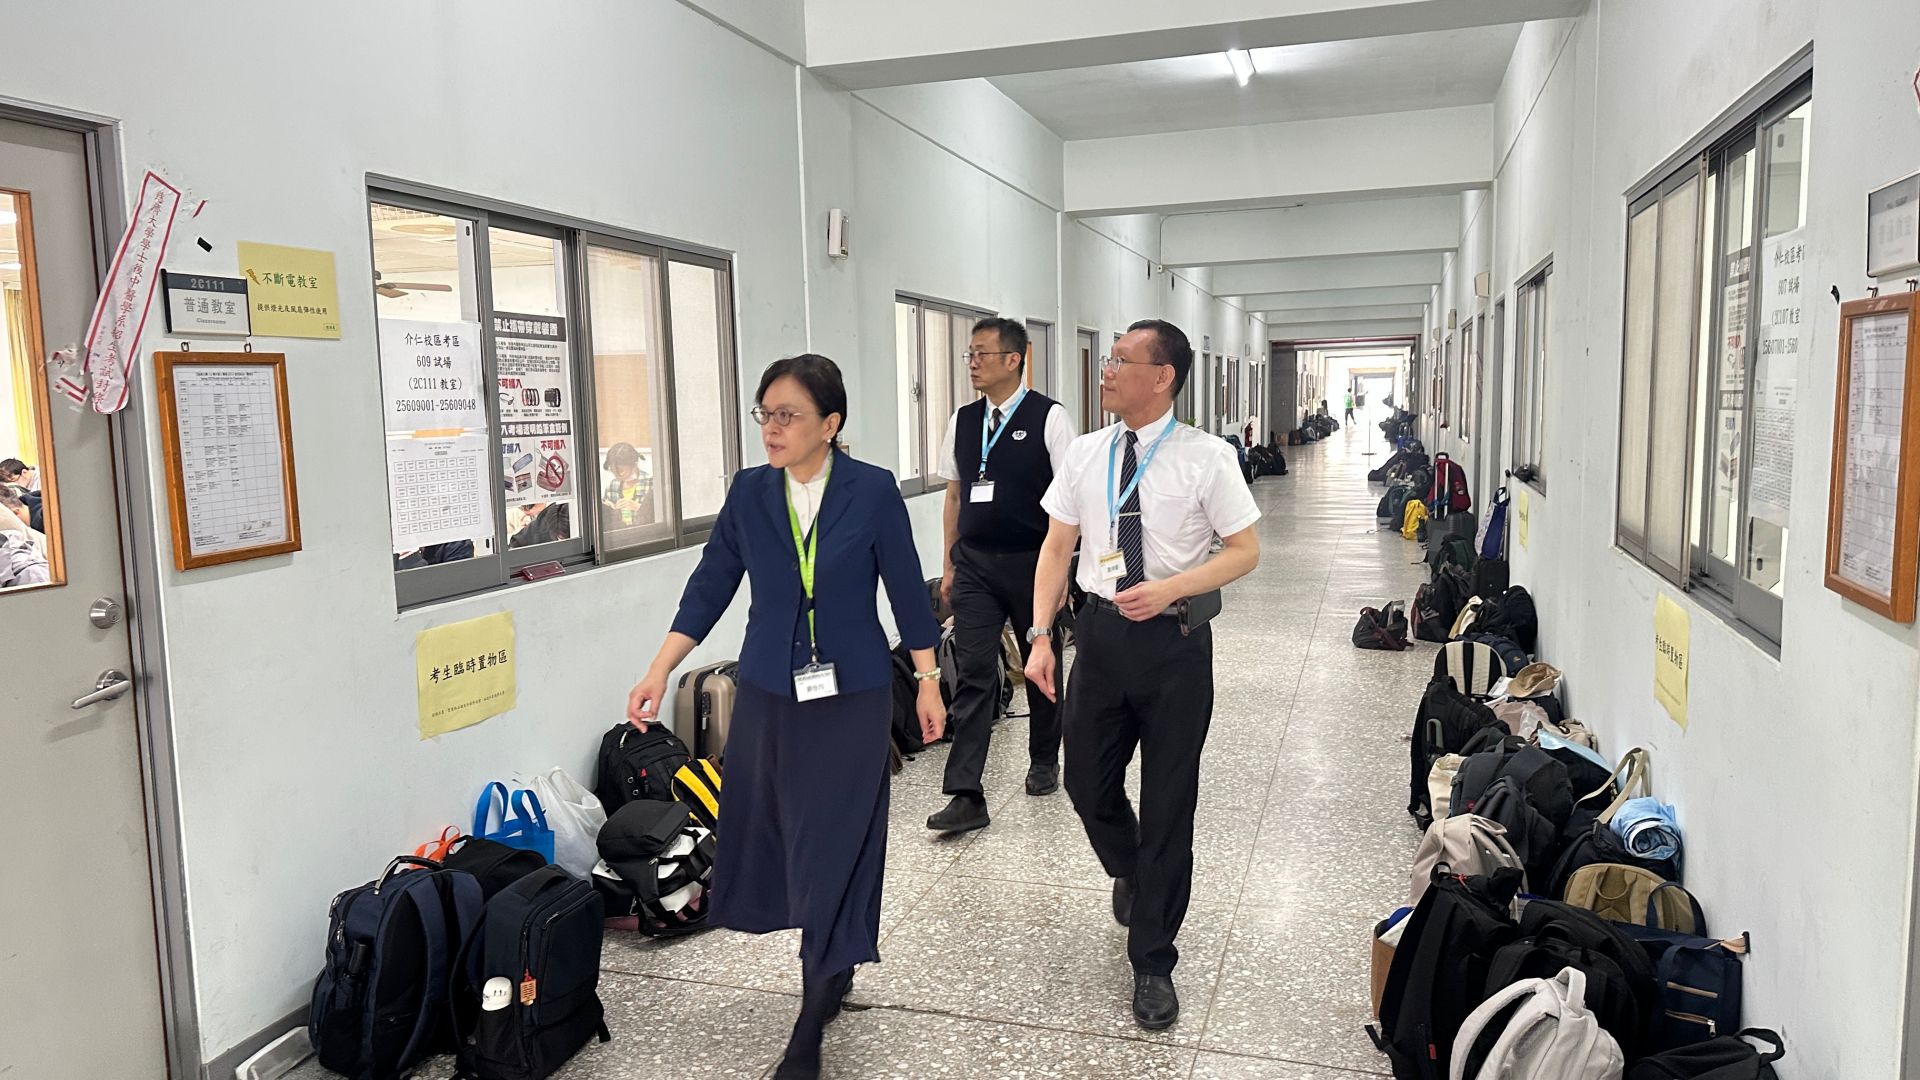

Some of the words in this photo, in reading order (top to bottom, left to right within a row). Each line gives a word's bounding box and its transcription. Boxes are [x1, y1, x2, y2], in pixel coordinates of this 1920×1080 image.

[262, 272, 318, 289] 不斷電教室
[184, 296, 236, 315] 普通教室
[404, 332, 460, 348] 介仁校區考區
[416, 357, 432, 369] 609
[433, 357, 452, 369] 試場
[408, 377, 438, 391] (2C111
[396, 399, 476, 412] 25609001-25609048
[429, 649, 508, 684] 考生臨時置物區
